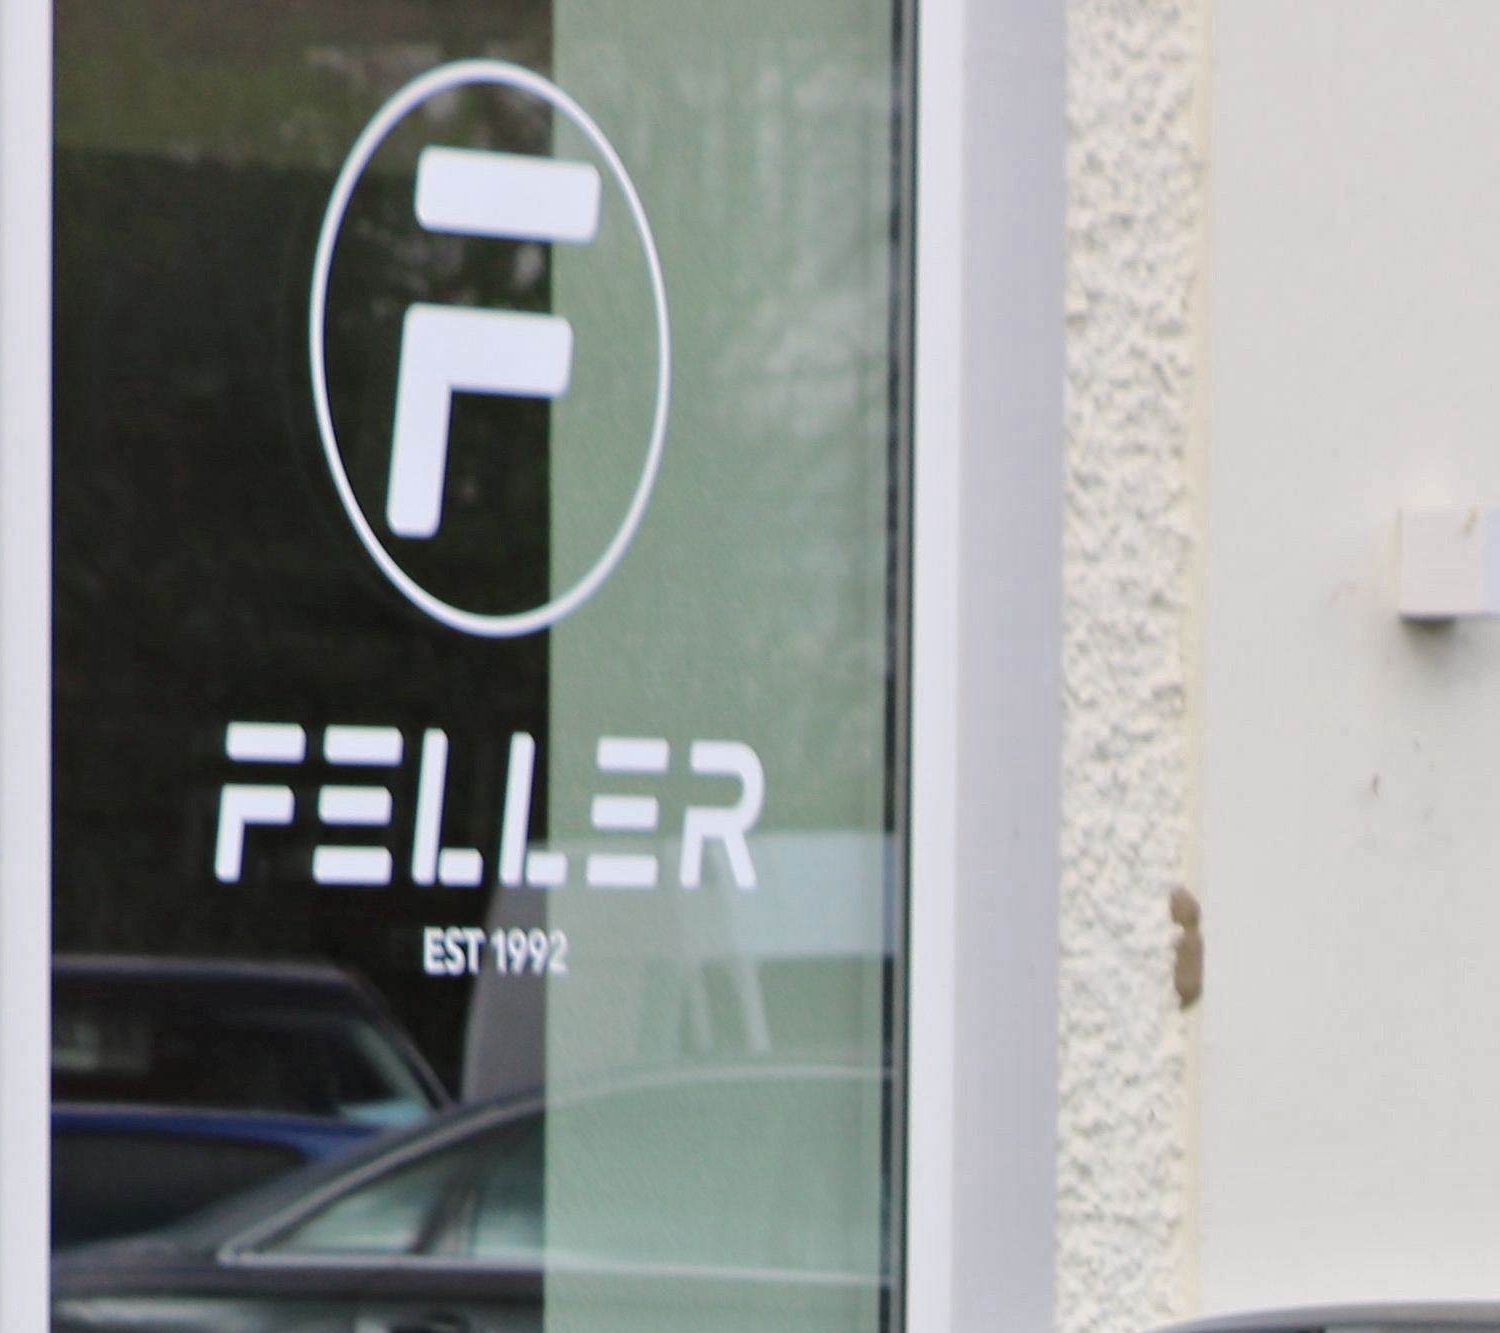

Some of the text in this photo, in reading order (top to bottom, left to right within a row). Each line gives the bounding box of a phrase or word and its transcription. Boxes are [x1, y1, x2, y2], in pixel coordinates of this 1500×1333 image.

[386, 145, 601, 540] F
[214, 721, 766, 889] FELLER
[423, 925, 570, 977] EST 1992
